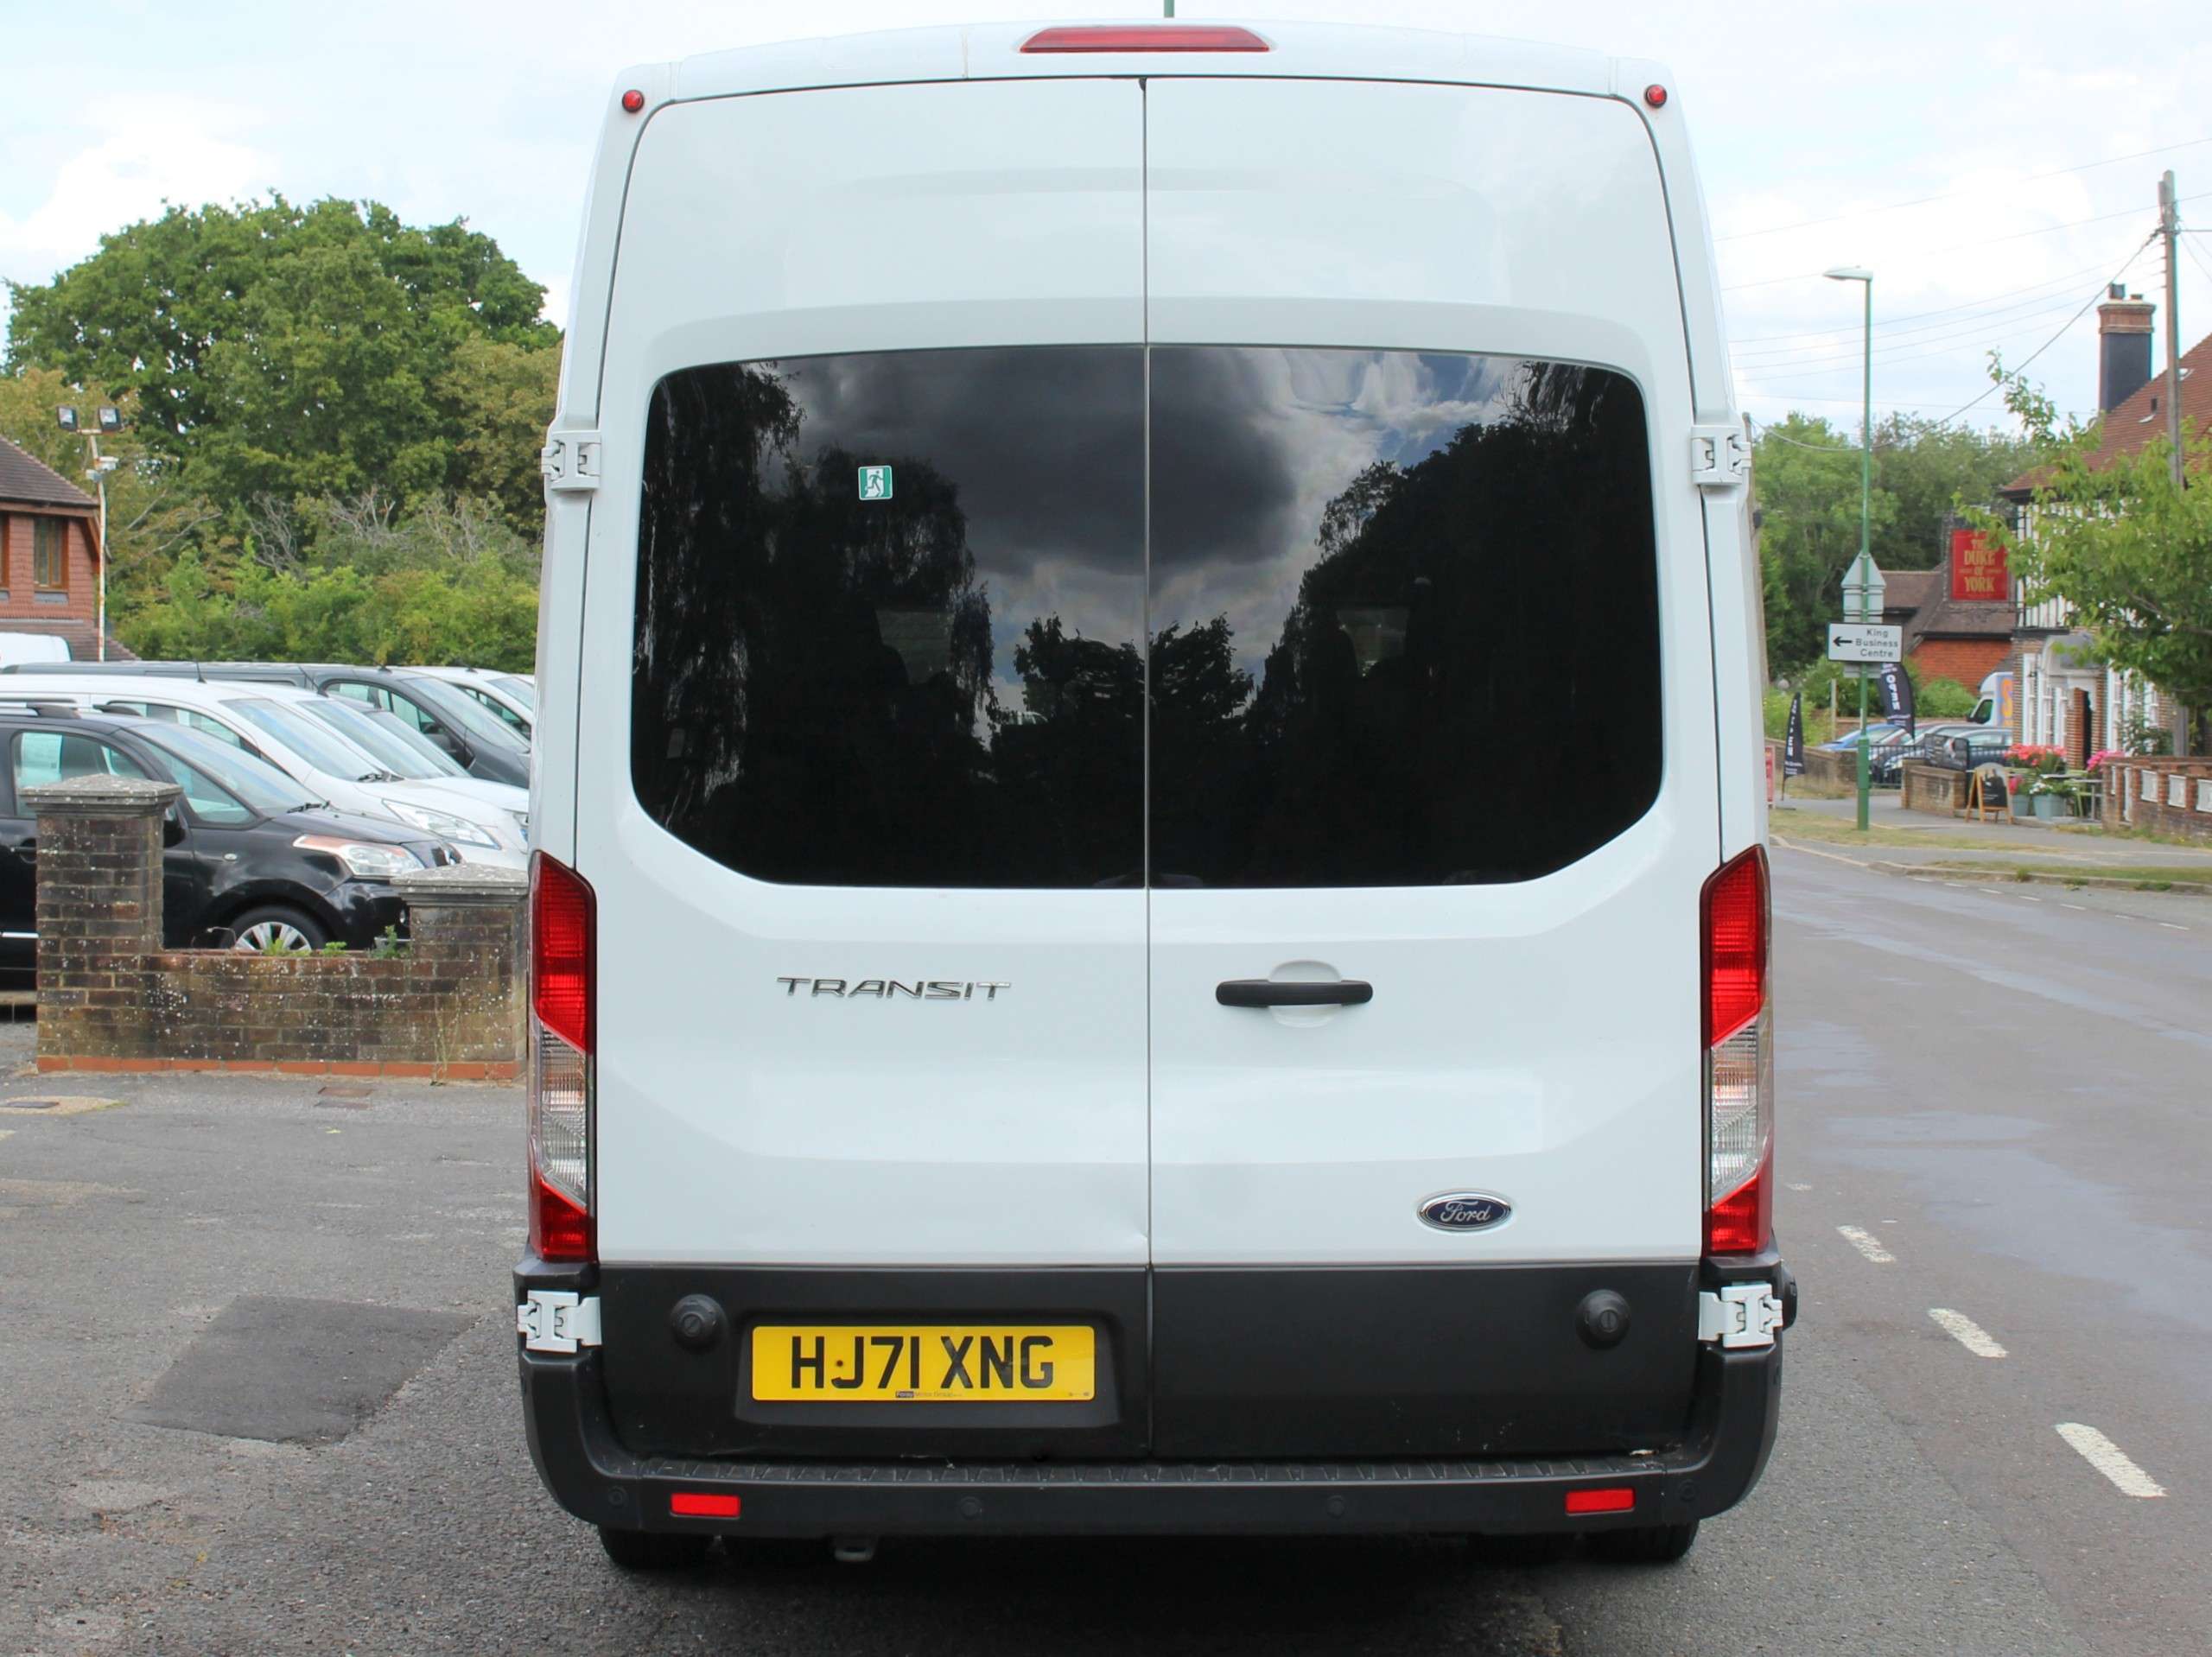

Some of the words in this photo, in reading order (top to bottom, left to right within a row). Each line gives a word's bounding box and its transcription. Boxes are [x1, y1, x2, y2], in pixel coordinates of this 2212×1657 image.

[1964, 550, 1995, 565] DUKE
[1964, 576, 1995, 593] YORK
[1866, 628, 1889, 638] King
[1855, 638, 1898, 647] Business
[1860, 648, 1894, 657] Centre
[777, 977, 1012, 1000] TRANSIT
[1440, 1200, 1491, 1222] Ford
[791, 1336, 918, 1389] HJ71
[940, 1336, 1054, 1389] XNG
